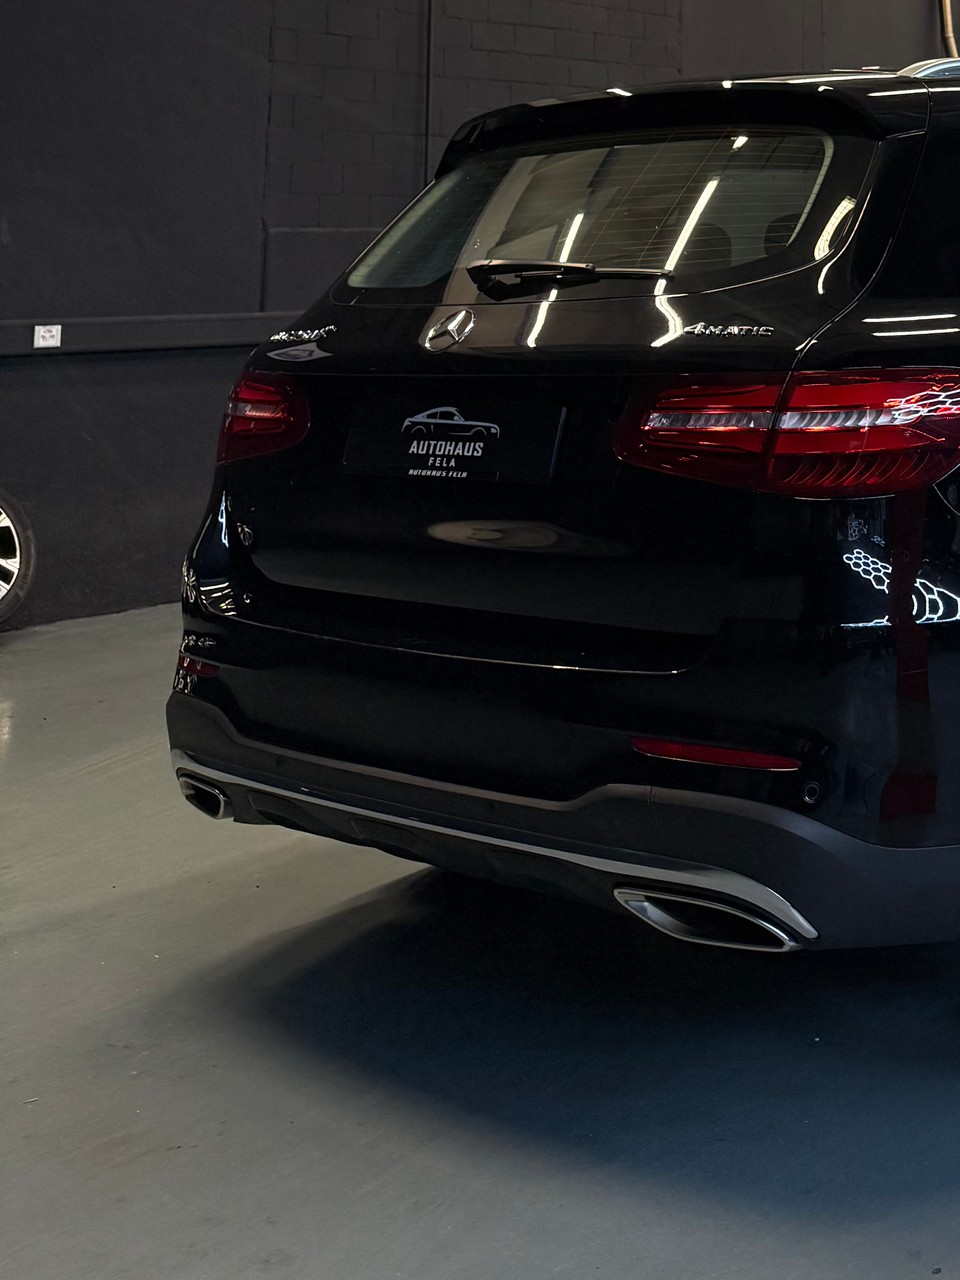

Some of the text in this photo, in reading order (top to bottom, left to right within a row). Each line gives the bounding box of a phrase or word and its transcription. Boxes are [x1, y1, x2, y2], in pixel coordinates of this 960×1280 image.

[683, 322, 774, 337] 4MATIC
[408, 440, 484, 457] AUTOHAUS
[428, 457, 456, 467] FELA
